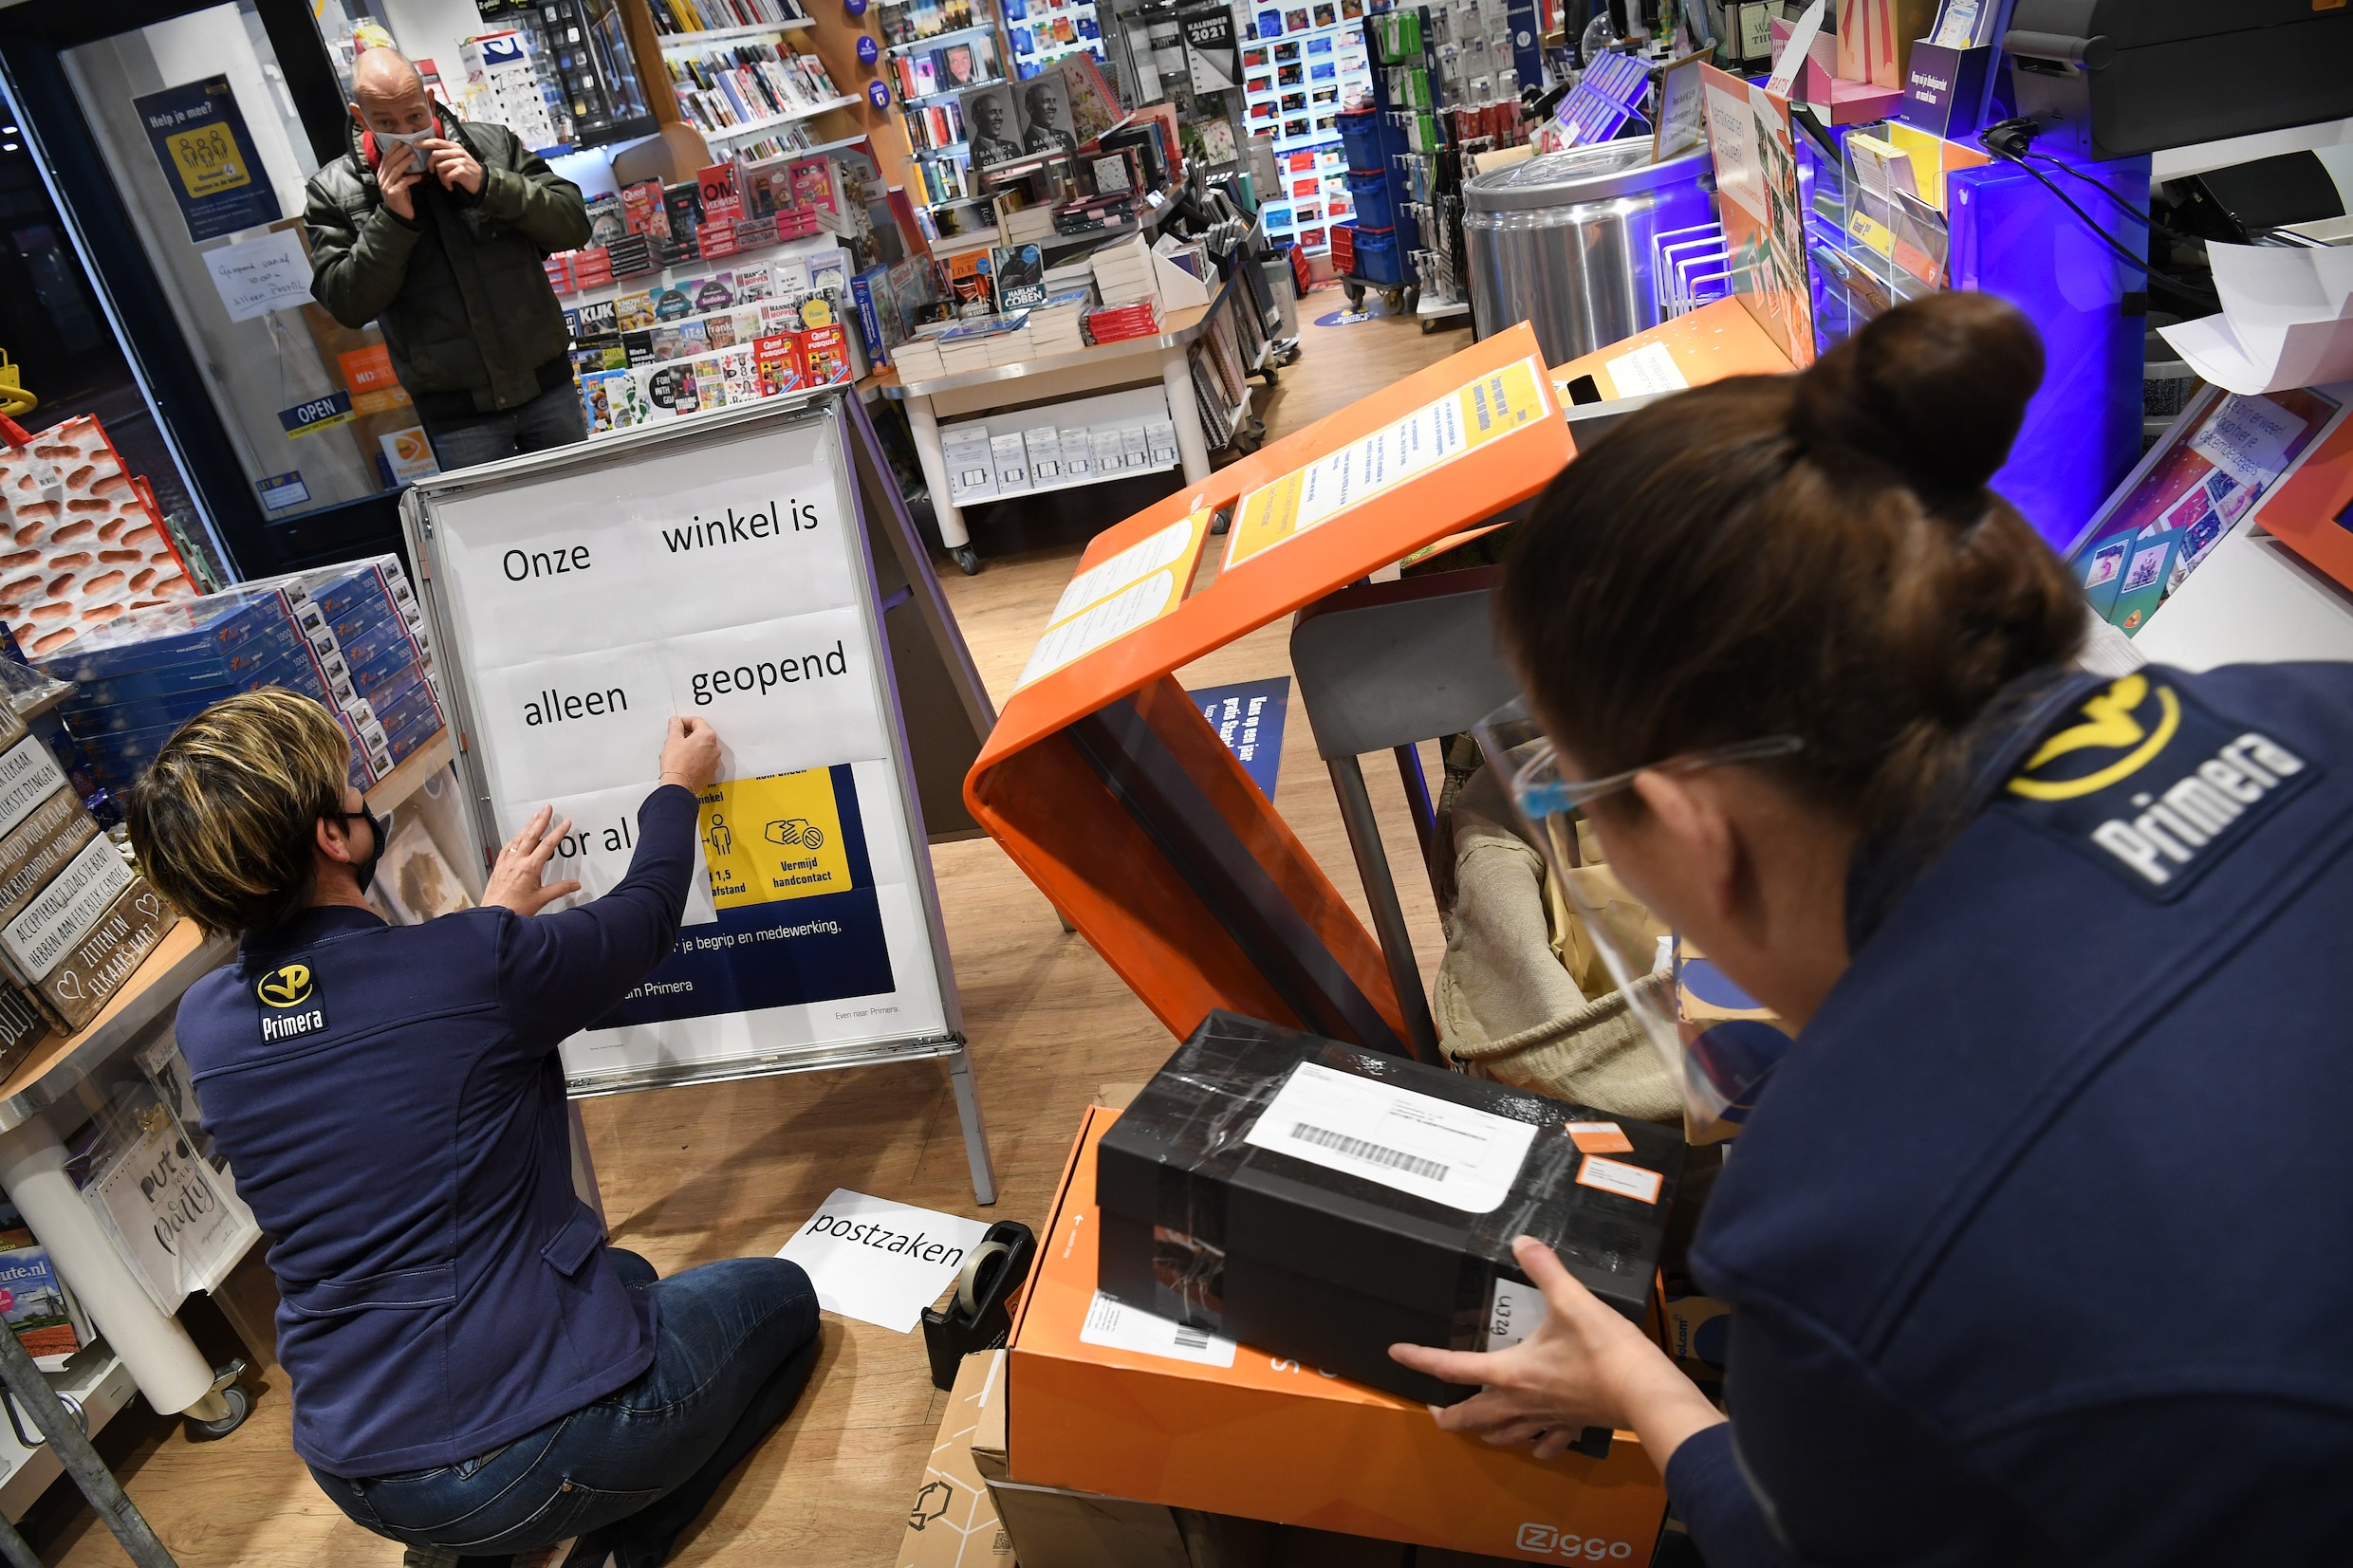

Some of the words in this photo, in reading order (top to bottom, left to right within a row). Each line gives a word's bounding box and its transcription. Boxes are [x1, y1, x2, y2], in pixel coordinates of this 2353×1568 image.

[1188, 16, 1228, 31] KALENDER
[1192, 27, 1226, 42] 2021
[1768, 76, 1789, 93] GRATIS
[149, 112, 173, 129] Help
[175, 109, 185, 124] je
[187, 101, 213, 119] mee?
[1032, 134, 1066, 146] BARACK
[979, 144, 1013, 157] BARACK
[1036, 143, 1066, 154] OBAMA
[984, 155, 1013, 166] OBAMA
[622, 187, 646, 201] Quest
[585, 202, 620, 216] happinez
[744, 275, 769, 287] MOPPEN
[1005, 291, 1043, 307] COBEN
[1008, 286, 1037, 297] HARLAN
[617, 297, 640, 309] KNOW
[702, 295, 726, 304] Sudoku
[769, 303, 796, 311] MANNEN
[579, 303, 615, 323] KIJK
[769, 308, 798, 319] MOPPEN
[811, 330, 830, 341] Quest
[764, 340, 783, 351] Quest
[807, 339, 837, 350] PUBQUIZ
[629, 348, 647, 357] Niets
[760, 348, 788, 359] PUBQUIZ
[655, 387, 670, 396] WITH
[297, 398, 336, 423] OPEN
[2236, 403, 2254, 419] zijn
[2259, 415, 2287, 439] weer!
[2214, 412, 2235, 434] Koop
[2233, 423, 2252, 442] hier
[2243, 433, 2258, 449] je
[2198, 428, 2261, 476] decemberzegels
[502, 541, 592, 581] Onze
[662, 500, 781, 554] winkel
[791, 498, 819, 532] is
[361, 575, 375, 588] 1000
[374, 600, 386, 612] 1000
[276, 629, 291, 643] 1000
[386, 623, 398, 636] 1000
[398, 647, 411, 659] 1000
[292, 654, 308, 668] 1000
[304, 677, 319, 691] 1000
[523, 682, 628, 727] alleen
[691, 640, 848, 706] geopend
[415, 691, 427, 703] 1000
[424, 713, 436, 727] 1000
[1, 751, 33, 782] ELKAAR
[23, 764, 57, 797] DINGEN
[2090, 731, 2306, 886] Primera
[4, 832, 28, 870] ALTIJD
[22, 821, 47, 846] VOOR
[39, 814, 53, 833] JE
[46, 798, 73, 826] KLAAR
[11, 846, 55, 897] BIJZONDERE
[51, 813, 93, 856] MOMENTEN
[781, 858, 818, 872] Vermijd
[715, 869, 732, 882] 1,5
[772, 871, 832, 888] handcontact
[15, 893, 60, 945] ACCEPTEREN
[58, 886, 70, 909] JE
[65, 867, 86, 898] ZOALS
[83, 858, 96, 881] JE
[91, 847, 111, 876] BENT
[28, 932, 57, 970] HEBBEN
[58, 914, 77, 940] AAN
[73, 901, 91, 926] EEN
[86, 886, 108, 913] BLIK
[102, 865, 130, 896] GENOEG
[79, 931, 115, 969] ZITTEN
[111, 914, 130, 938] IN
[682, 938, 694, 954] je
[695, 933, 734, 951] begrip
[738, 932, 753, 945] en
[756, 920, 842, 942] medewerking,
[88, 948, 136, 997] ELKAARS
[131, 923, 157, 959] HART
[644, 980, 694, 997] Primera
[835, 1010, 851, 1020] Even
[853, 1009, 868, 1018] naar
[870, 1005, 900, 1016] Primera.
[262, 1008, 324, 1042] Primera
[155, 1175, 214, 1256] party
[806, 1210, 964, 1268] postzaken
[1063, 1248, 1071, 1259] Hier
[1067, 1229, 1077, 1248] openen
[1676, 1319, 1688, 1361] bol.com
[1516, 1522, 1632, 1560] Ziggo
